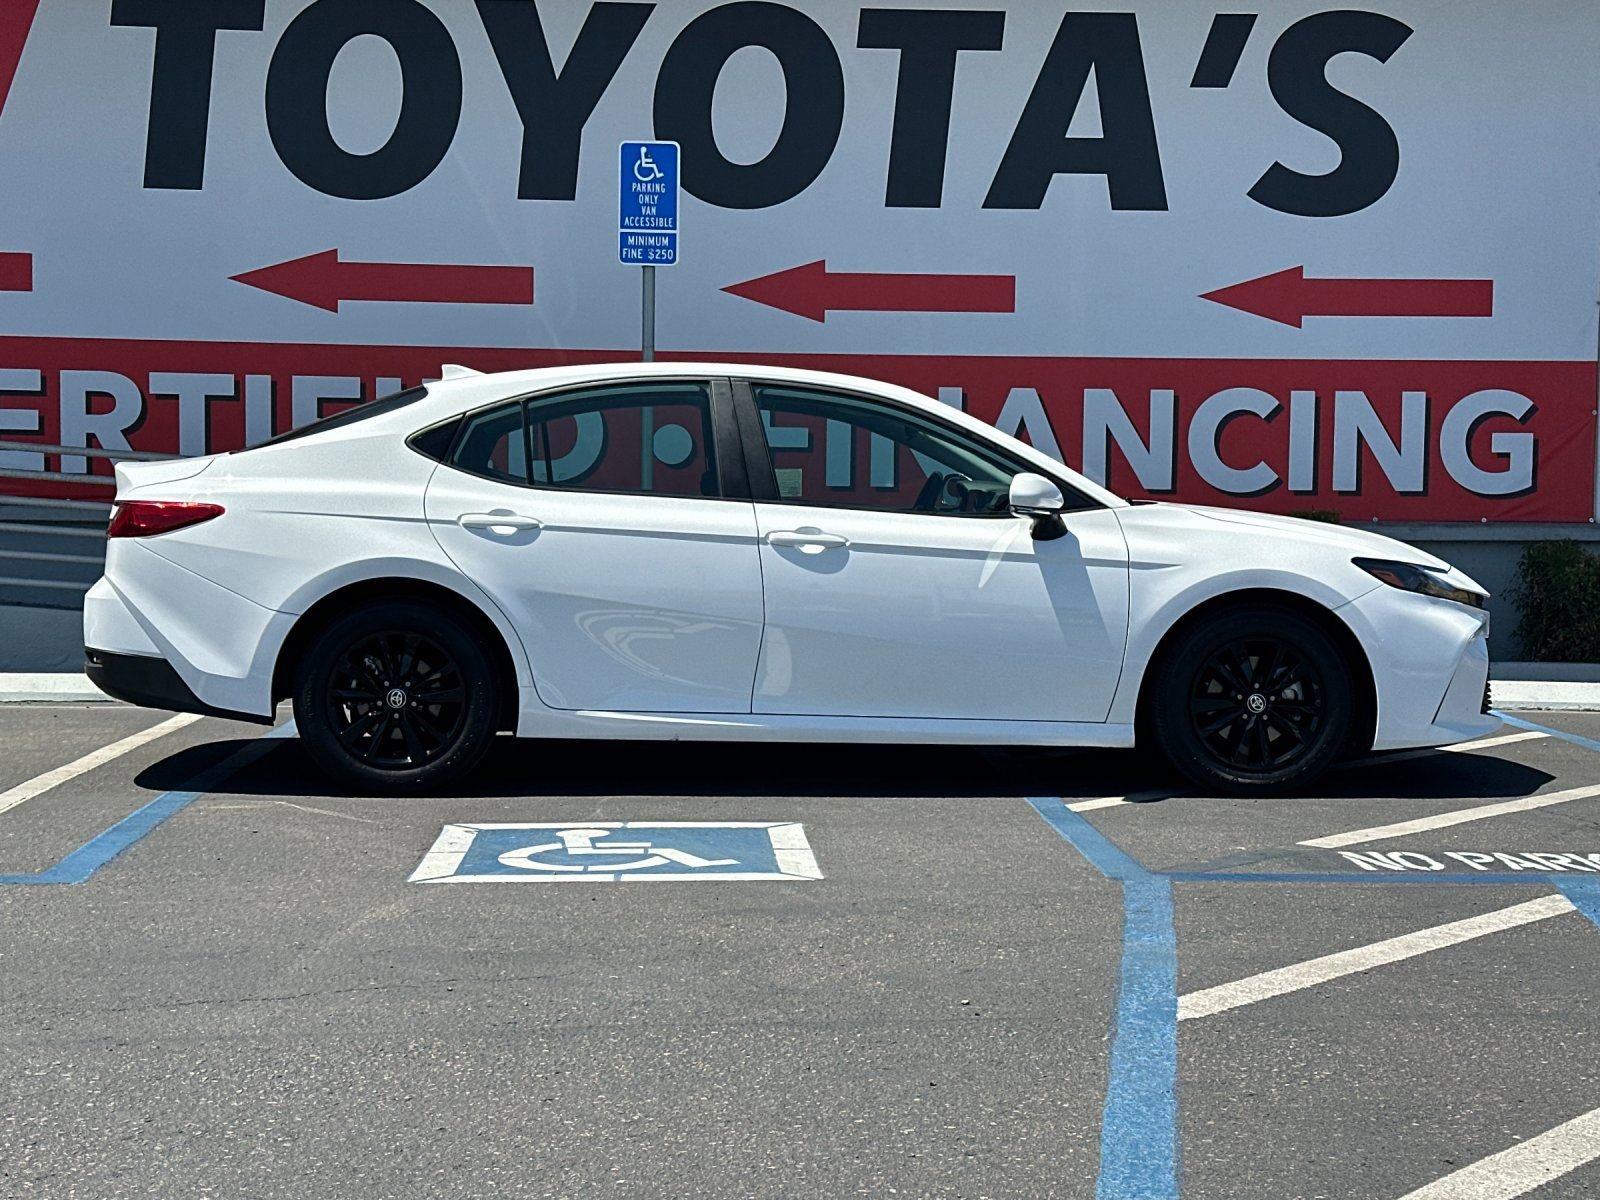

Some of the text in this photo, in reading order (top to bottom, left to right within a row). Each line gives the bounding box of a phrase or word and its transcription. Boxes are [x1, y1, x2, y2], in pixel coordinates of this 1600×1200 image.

[110, 0, 1415, 218] TOYOTA'S
[632, 183, 666, 193] PARKING
[638, 194, 659, 204] ONLY
[641, 206, 657, 215] VAN
[624, 216, 673, 227] ACCESSIBLE
[627, 235, 669, 247] MINIMUM
[622, 248, 674, 260] FINE $250
[1338, 851, 1446, 871] NO
